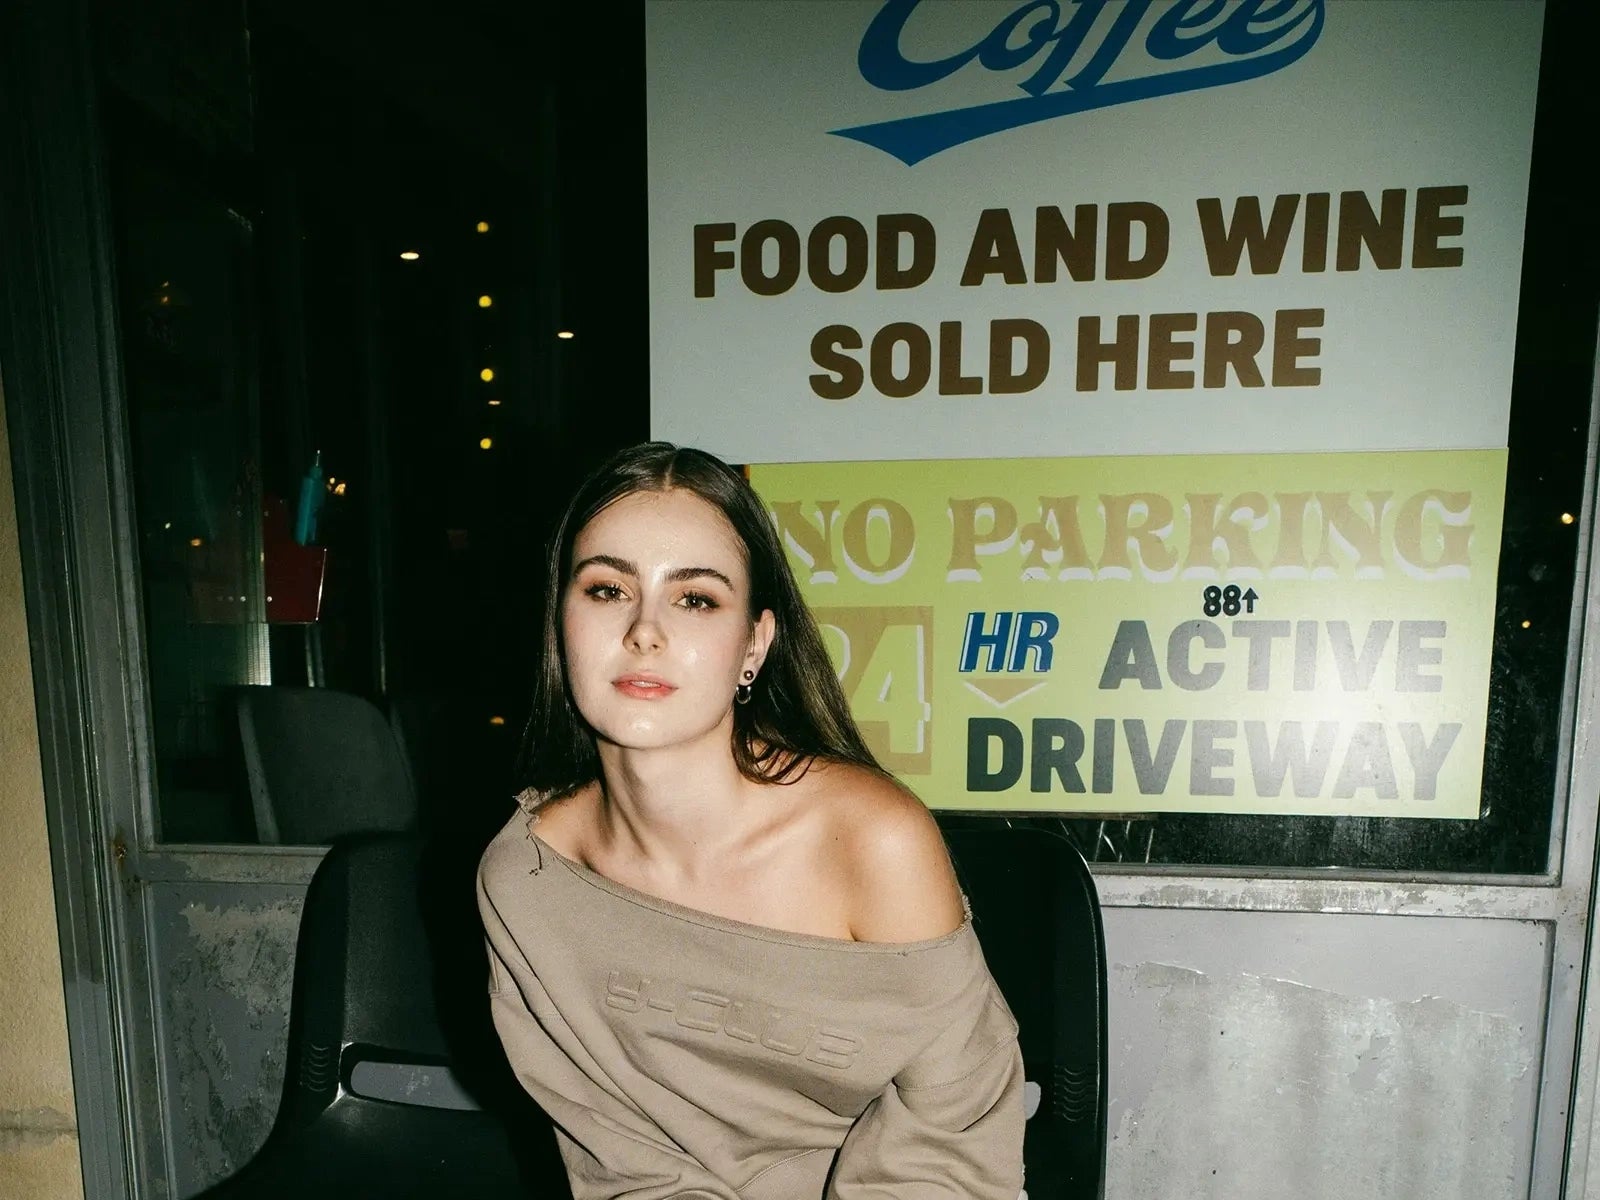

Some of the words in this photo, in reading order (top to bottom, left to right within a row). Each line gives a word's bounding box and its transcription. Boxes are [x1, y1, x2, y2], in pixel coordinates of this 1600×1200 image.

[858, 0, 1324, 97] Coffee
[693, 213, 936, 299] FOOD
[960, 201, 1170, 287] AND
[1196, 185, 1469, 277] WINE
[809, 318, 1051, 400] SOLD
[1075, 308, 1325, 392] HERE
[770, 497, 915, 584] NO
[945, 489, 1473, 583] PARKING
[958, 611, 1059, 673] HR
[1203, 584, 1241, 617] 88
[819, 624, 931, 753] 4
[1098, 620, 1446, 693] ACTIVE
[966, 717, 1463, 800] DRIVEWAY
